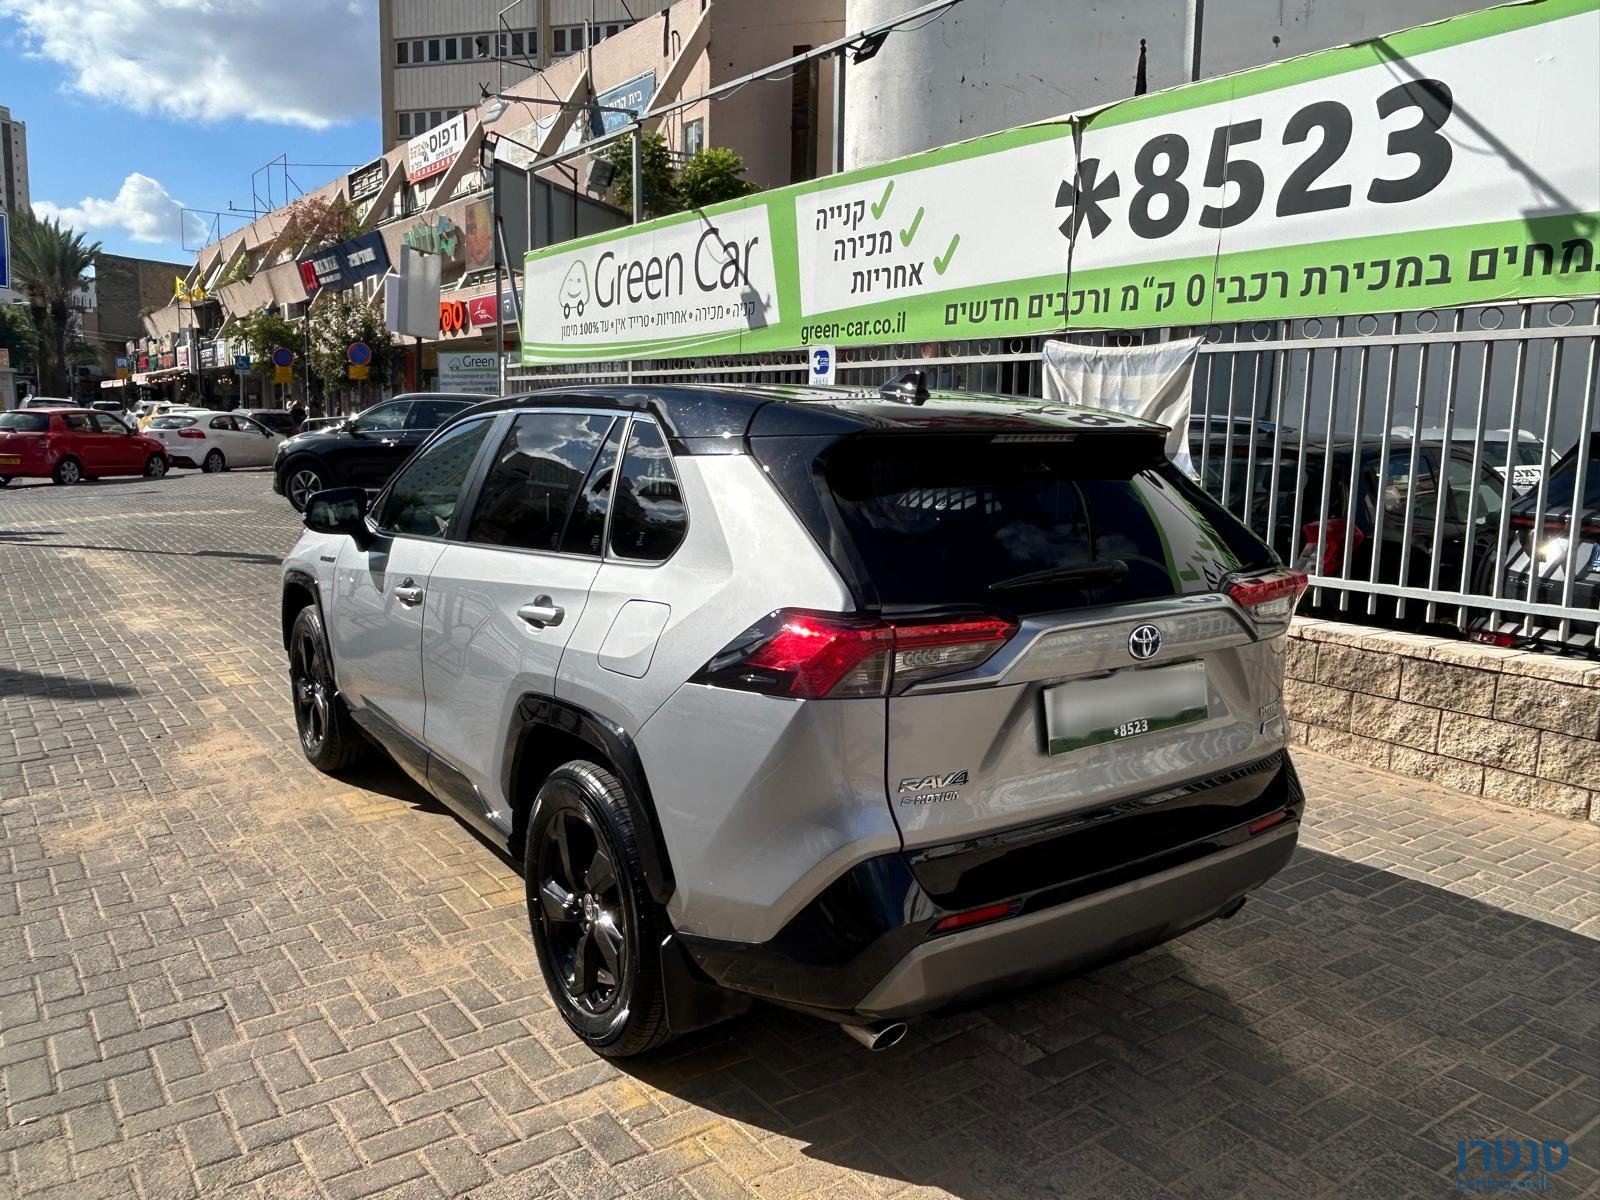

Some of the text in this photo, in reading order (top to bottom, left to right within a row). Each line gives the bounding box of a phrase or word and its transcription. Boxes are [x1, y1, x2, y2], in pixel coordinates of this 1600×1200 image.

[429, 122, 458, 153] דפוס
[816, 200, 866, 231] קנייה
[834, 230, 893, 261] מכירה
[1468, 238, 1600, 282] מחים
[595, 227, 759, 308] Green Car
[850, 262, 924, 294] אחריות
[1300, 253, 1452, 297] במכירת
[1028, 287, 1111, 319] ורכבים
[1215, 270, 1289, 304] רכבי
[561, 302, 755, 341] קניה מכירה אחריות טרייד אין עד 100% מימון
[944, 297, 1019, 325] חדשים
[801, 311, 907, 345] green-car.co.il
[462, 355, 495, 368] Green
[898, 769, 969, 794] RAV4
